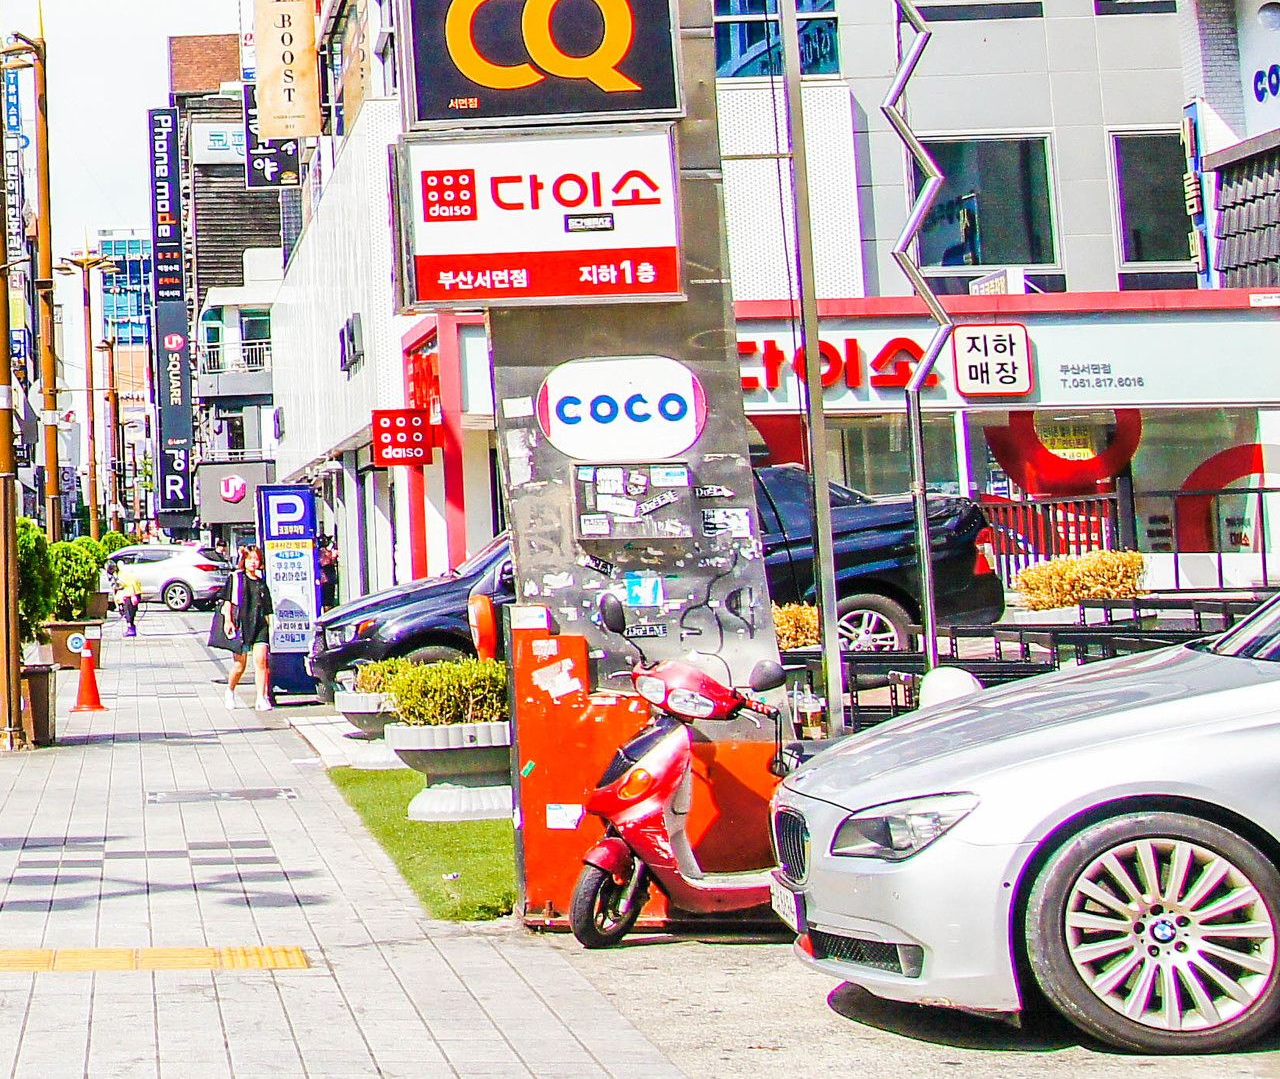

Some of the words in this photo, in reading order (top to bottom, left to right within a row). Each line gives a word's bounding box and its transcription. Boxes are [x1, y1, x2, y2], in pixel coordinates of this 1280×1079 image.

[274, 13, 296, 103] BOOST
[448, 96, 479, 110] 서면점
[490, 169, 661, 211] 다이소
[429, 203, 471, 218] daiso
[438, 268, 528, 291] 부산서면점
[966, 332, 1019, 359] 지하
[739, 336, 938, 389] 다이소
[968, 359, 1020, 388] 매장
[167, 353, 182, 406] SQUARE
[556, 392, 689, 425] COCO
[381, 445, 425, 460] daiso
[268, 494, 305, 536] P
